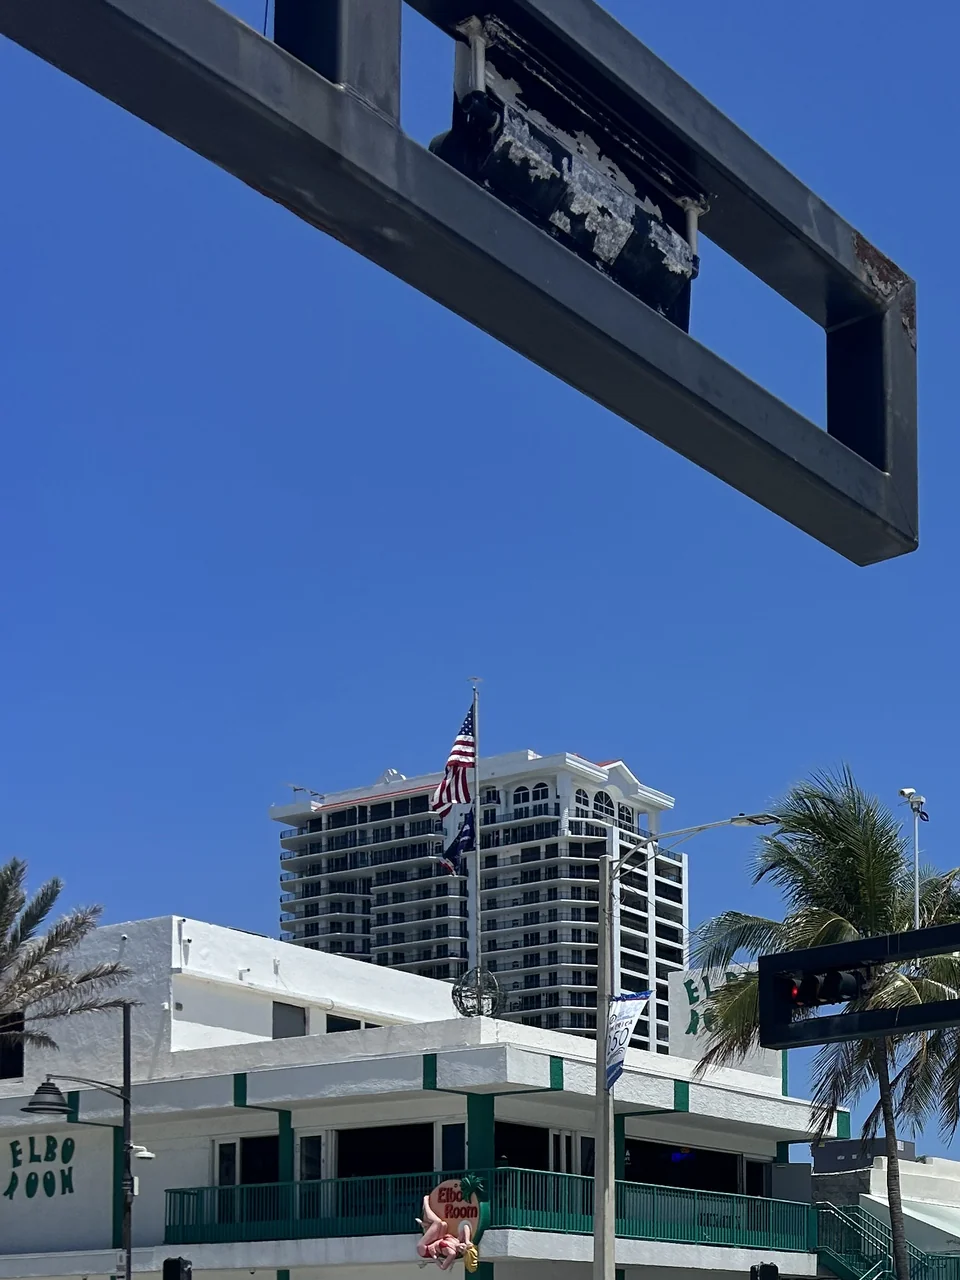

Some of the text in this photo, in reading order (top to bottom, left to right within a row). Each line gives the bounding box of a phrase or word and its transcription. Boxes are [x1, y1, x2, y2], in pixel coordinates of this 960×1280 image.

[609, 1019, 632, 1032] ERICA
[9, 1135, 75, 1168] ELBO
[3, 1166, 74, 1200] ROOM
[438, 1187, 463, 1203] Elbo
[444, 1204, 477, 1219] Room
